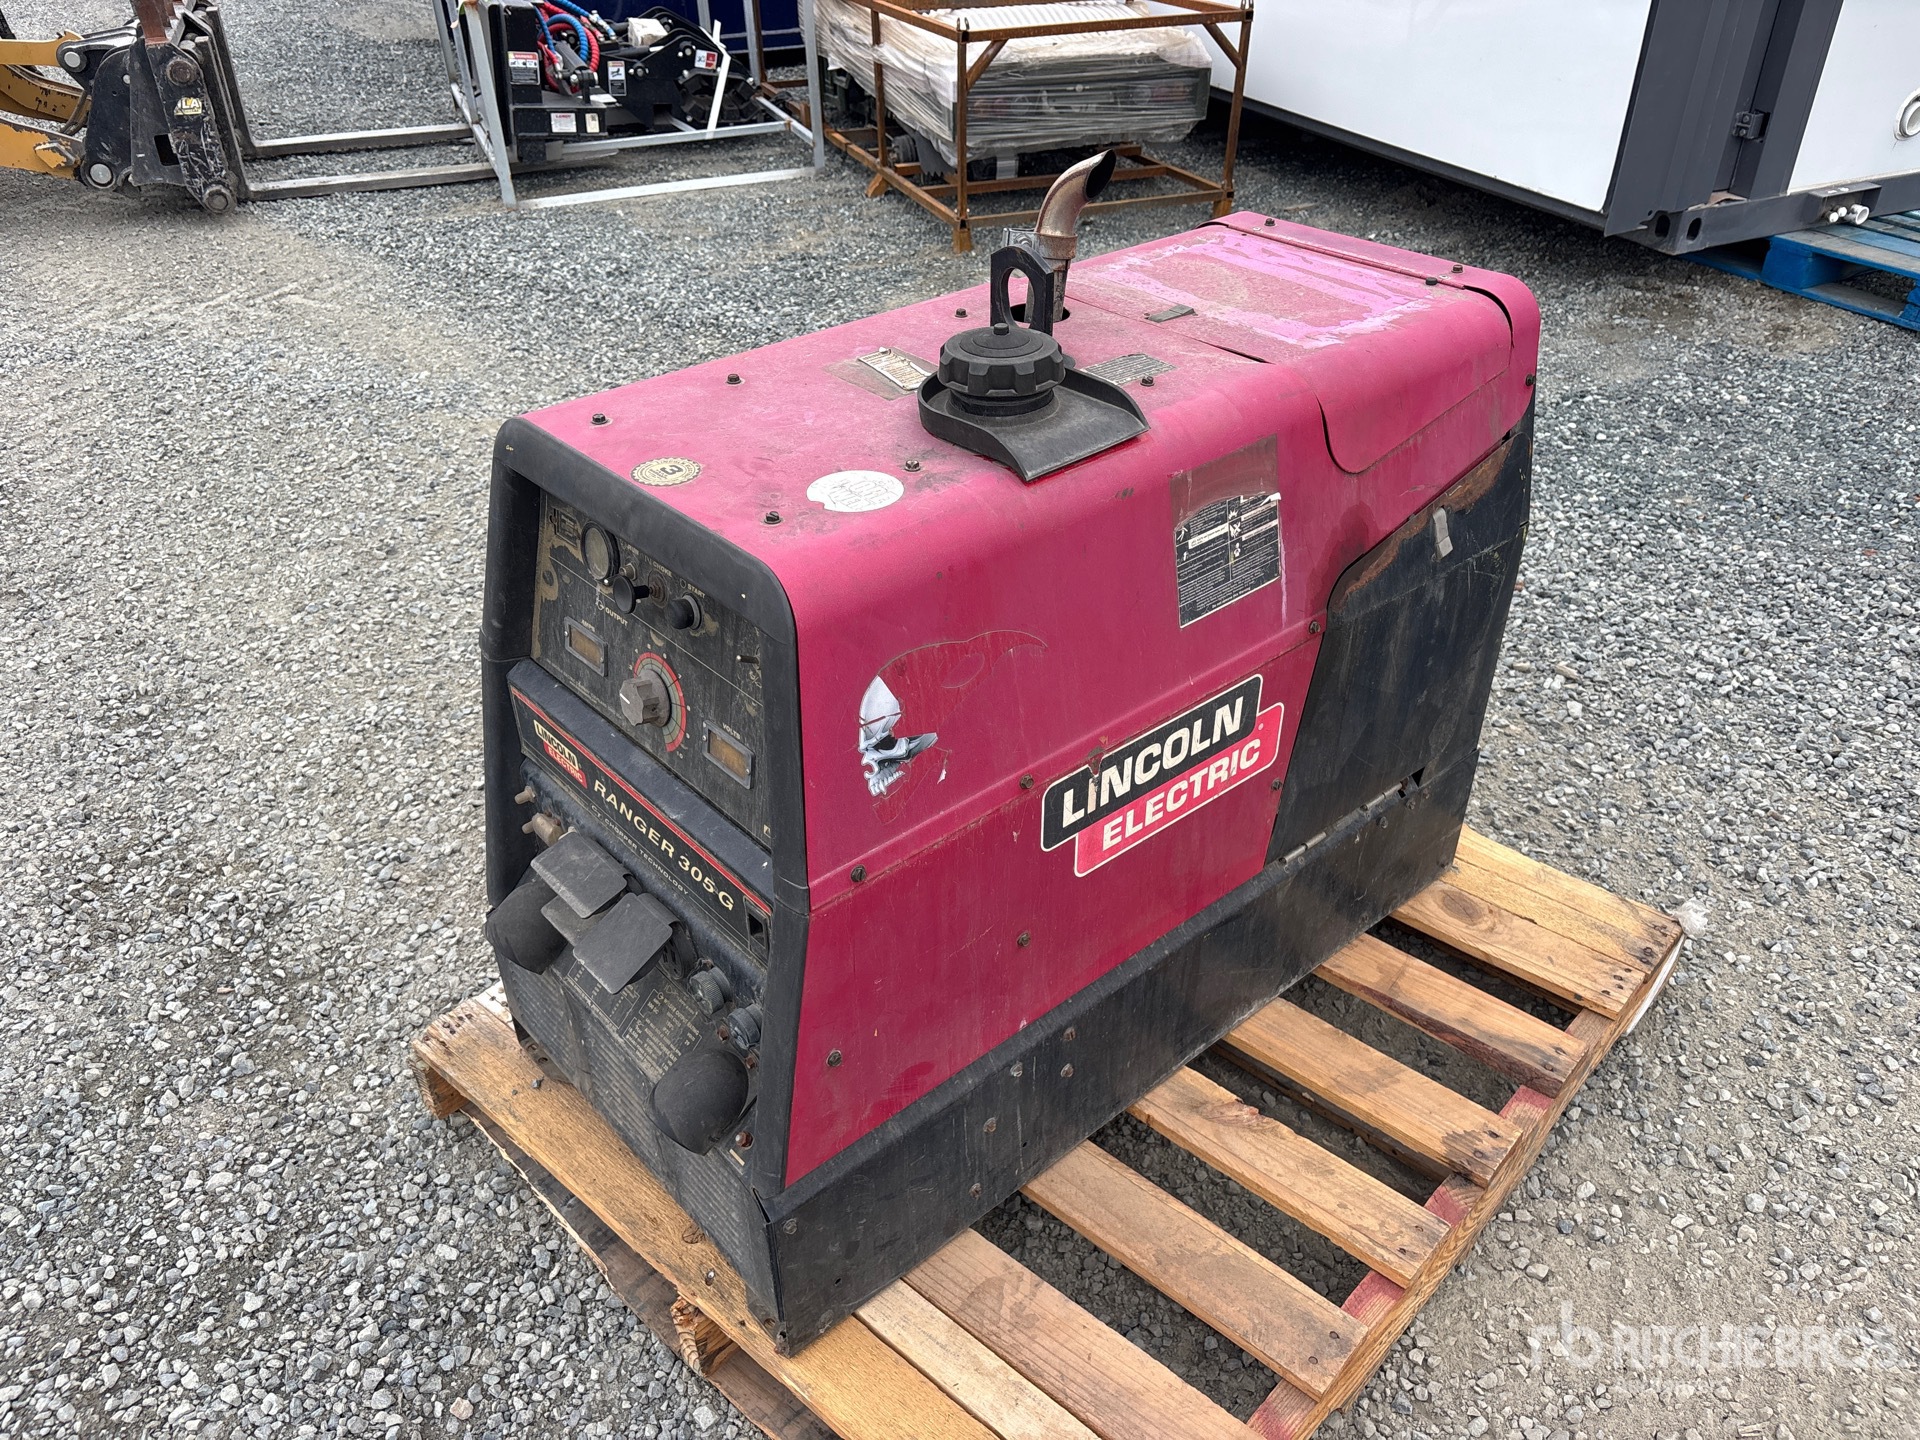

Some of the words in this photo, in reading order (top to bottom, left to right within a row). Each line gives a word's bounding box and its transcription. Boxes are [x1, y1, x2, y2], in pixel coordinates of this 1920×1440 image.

[653, 562, 673, 578] CHOKE
[687, 583, 706, 599] START
[605, 607, 628, 627] OUTPUT
[536, 723, 578, 769] LINCOLN
[722, 722, 741, 740] VOLTS
[548, 745, 583, 783] ELECTRIC
[1062, 696, 1243, 829] LINCOLN
[1102, 738, 1261, 852] ELECTRIC
[593, 779, 675, 859] RANGER
[604, 819, 638, 851] CHOPPER
[639, 848, 689, 895] TECHNOLOGY
